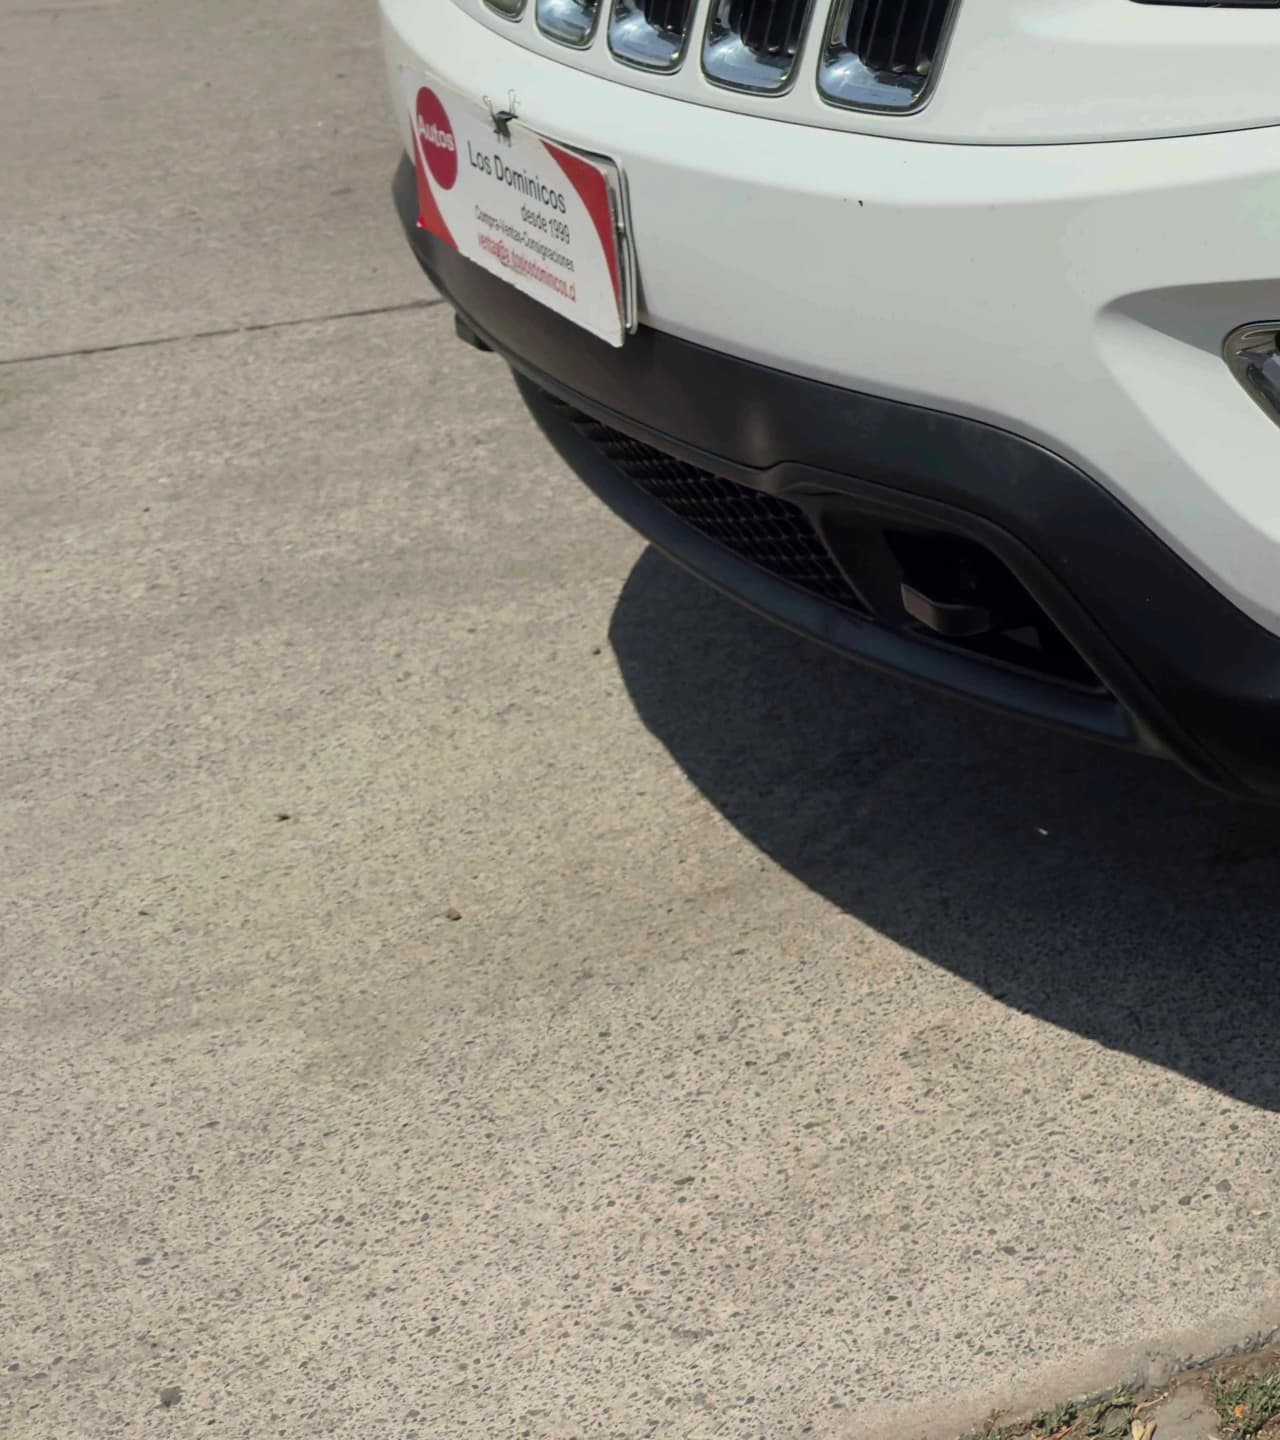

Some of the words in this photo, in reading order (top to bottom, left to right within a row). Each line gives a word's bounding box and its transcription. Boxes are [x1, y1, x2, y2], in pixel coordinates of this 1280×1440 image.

[417, 114, 455, 151] Autos
[467, 139, 492, 176] Los
[494, 154, 567, 214] Dominicos
[521, 203, 548, 234] desde
[548, 218, 570, 245] 1999
